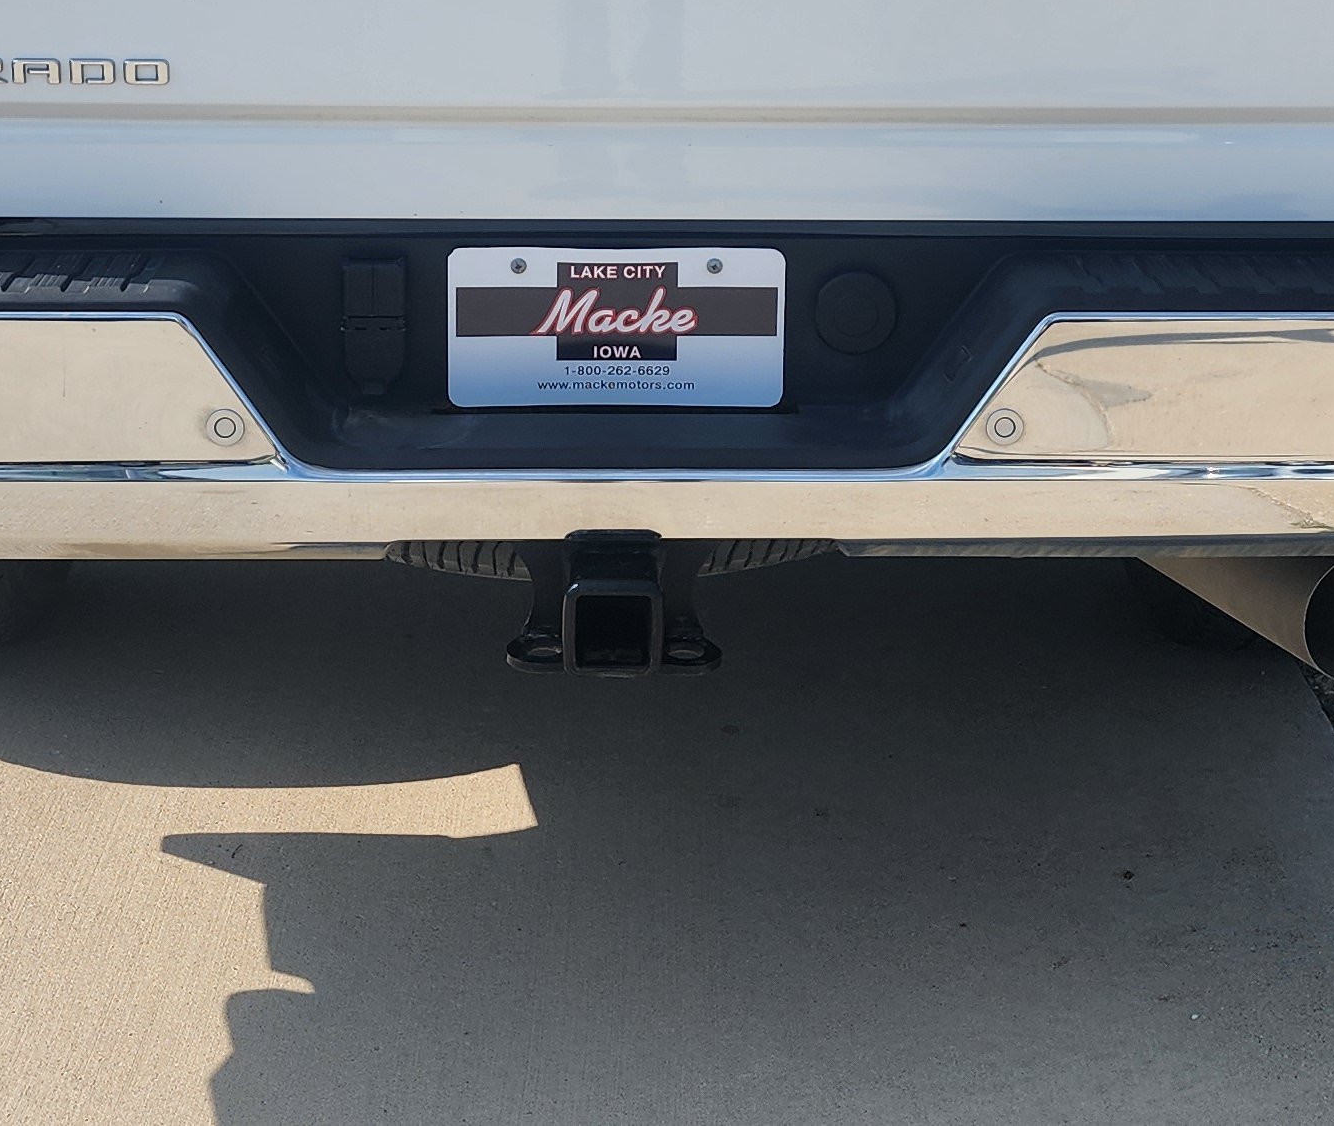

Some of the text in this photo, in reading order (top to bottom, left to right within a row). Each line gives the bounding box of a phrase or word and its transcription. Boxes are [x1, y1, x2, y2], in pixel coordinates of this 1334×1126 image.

[570, 265, 666, 279] LAKE CITY
[532, 285, 698, 335] Macke
[593, 345, 642, 359] IOWA
[564, 365, 670, 376] 1-800-262-6629
[537, 379, 695, 391] www.mackemotors.com
